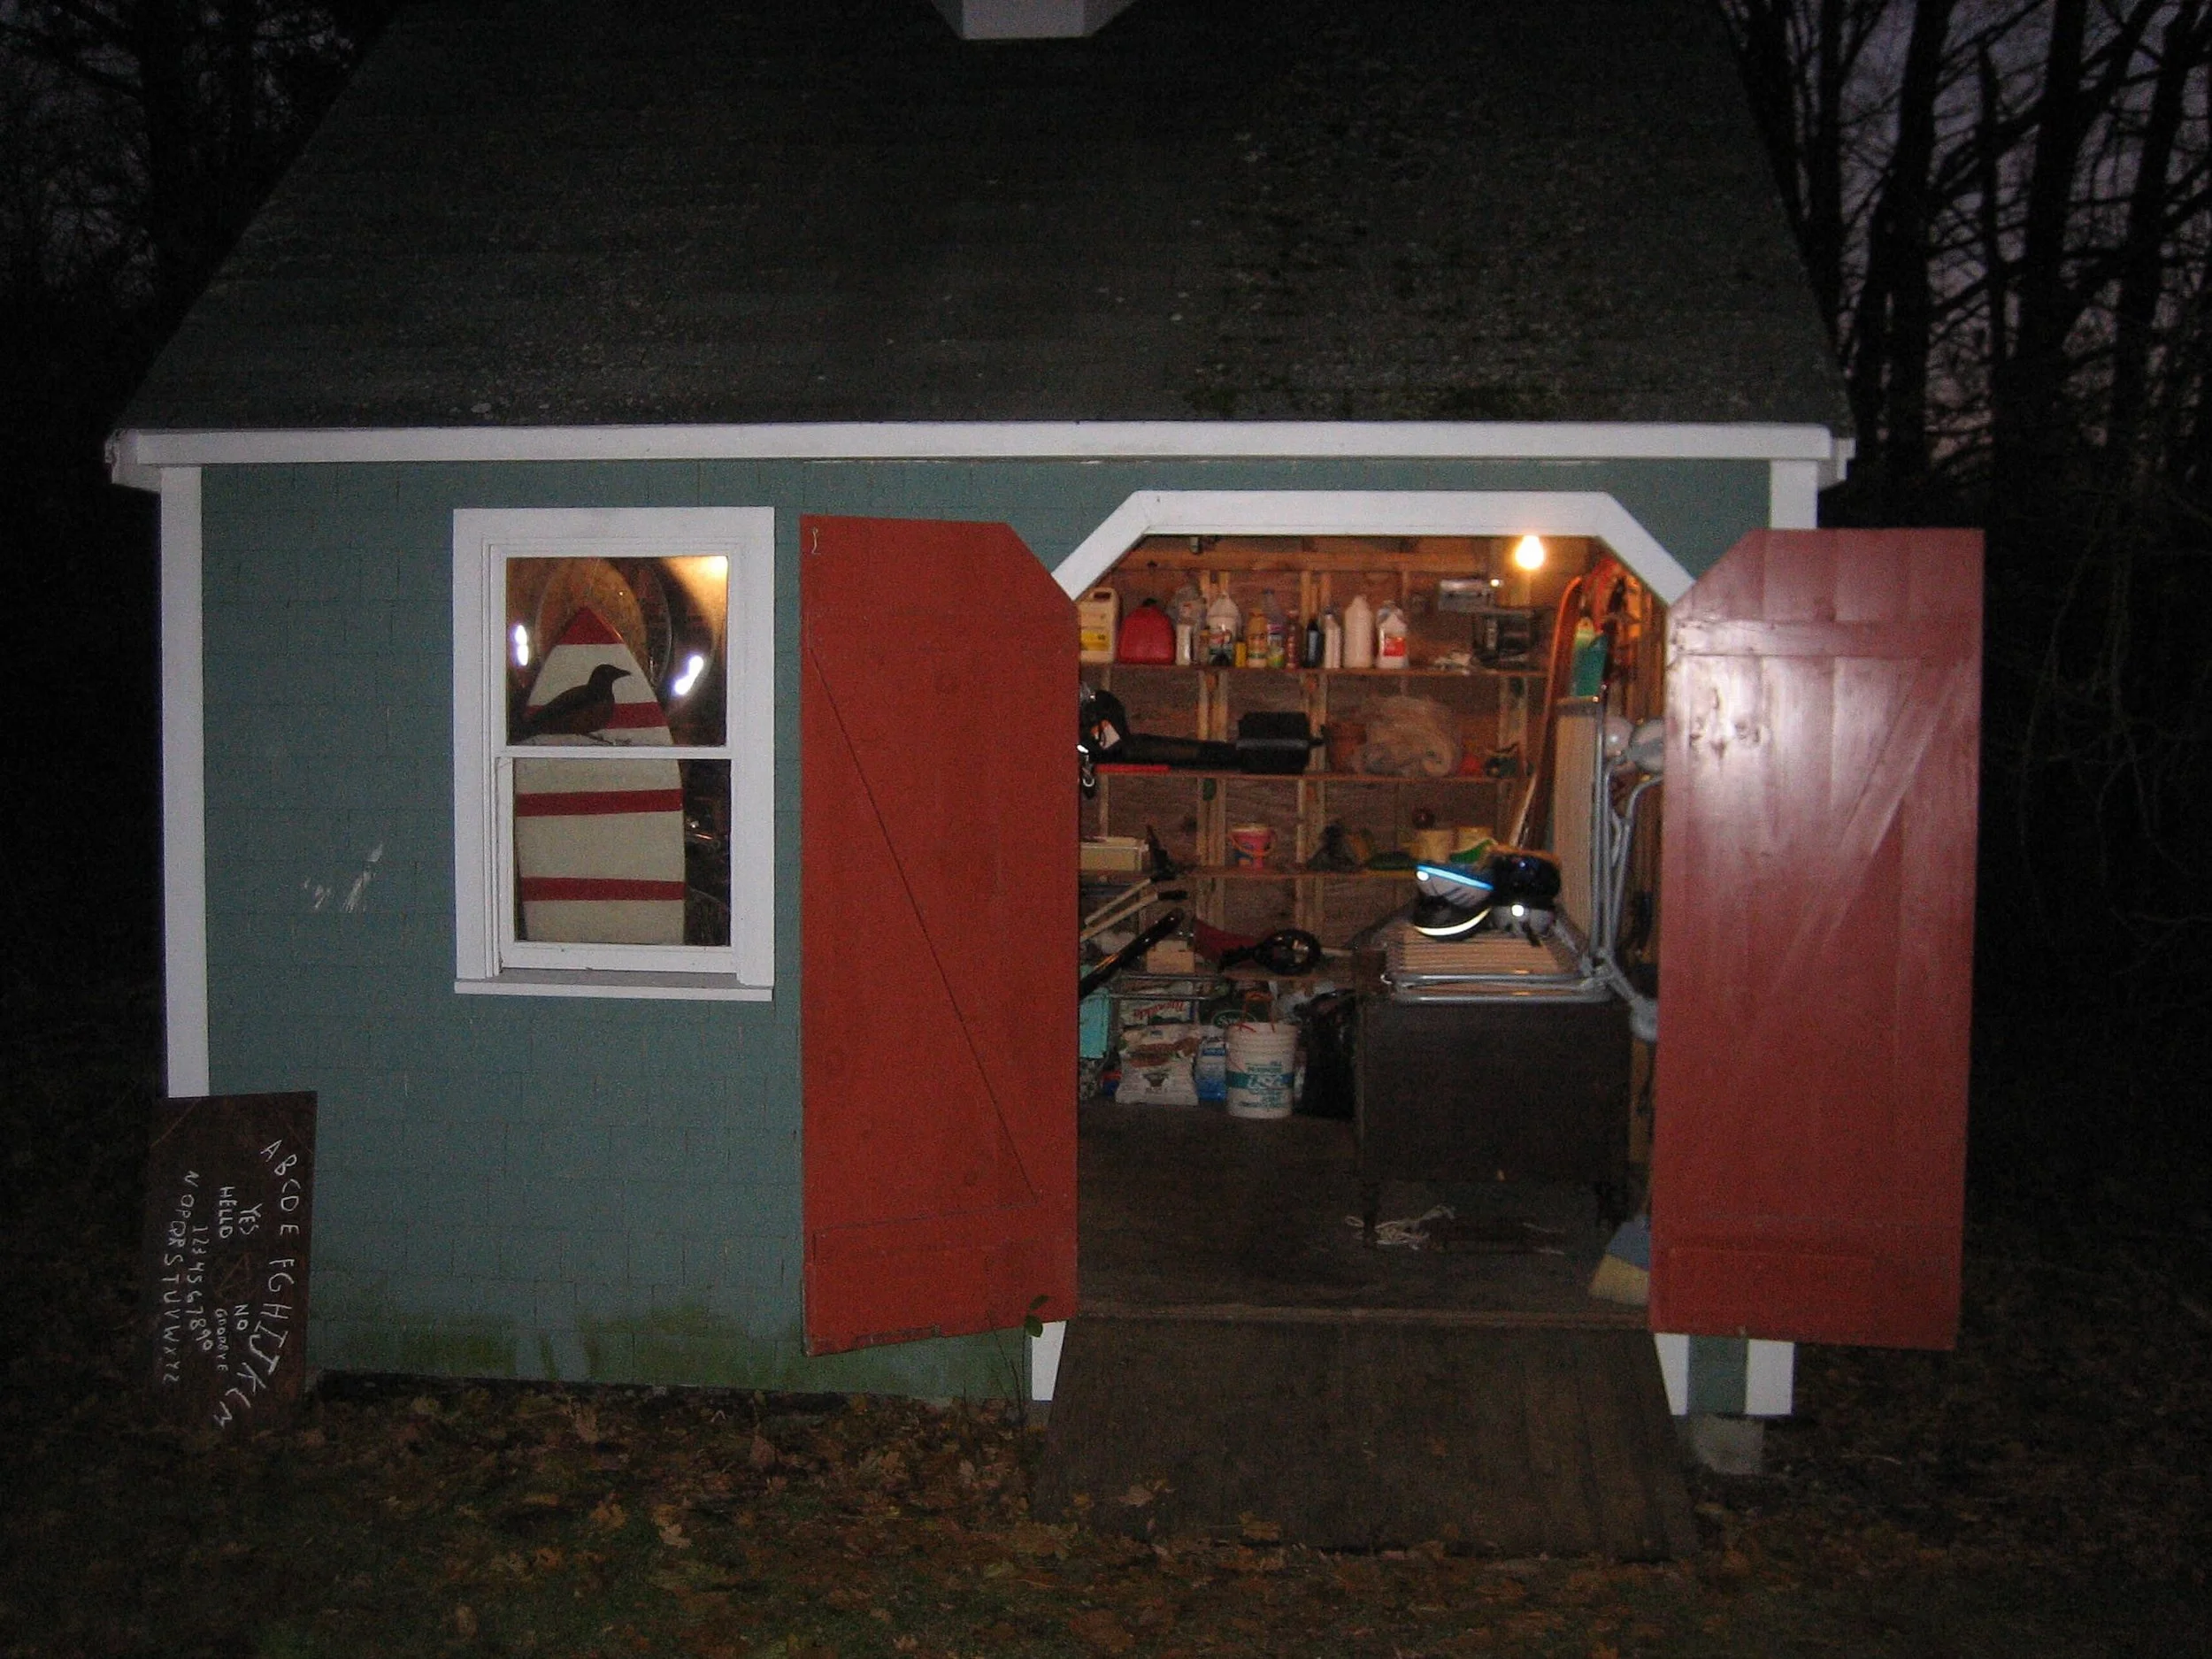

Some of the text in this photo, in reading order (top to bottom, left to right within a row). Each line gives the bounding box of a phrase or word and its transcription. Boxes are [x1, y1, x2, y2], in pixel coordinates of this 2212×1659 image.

[219, 1186, 237, 1240] HELLO
[239, 1202, 265, 1236] YES
[234, 1303, 249, 1332] NO
